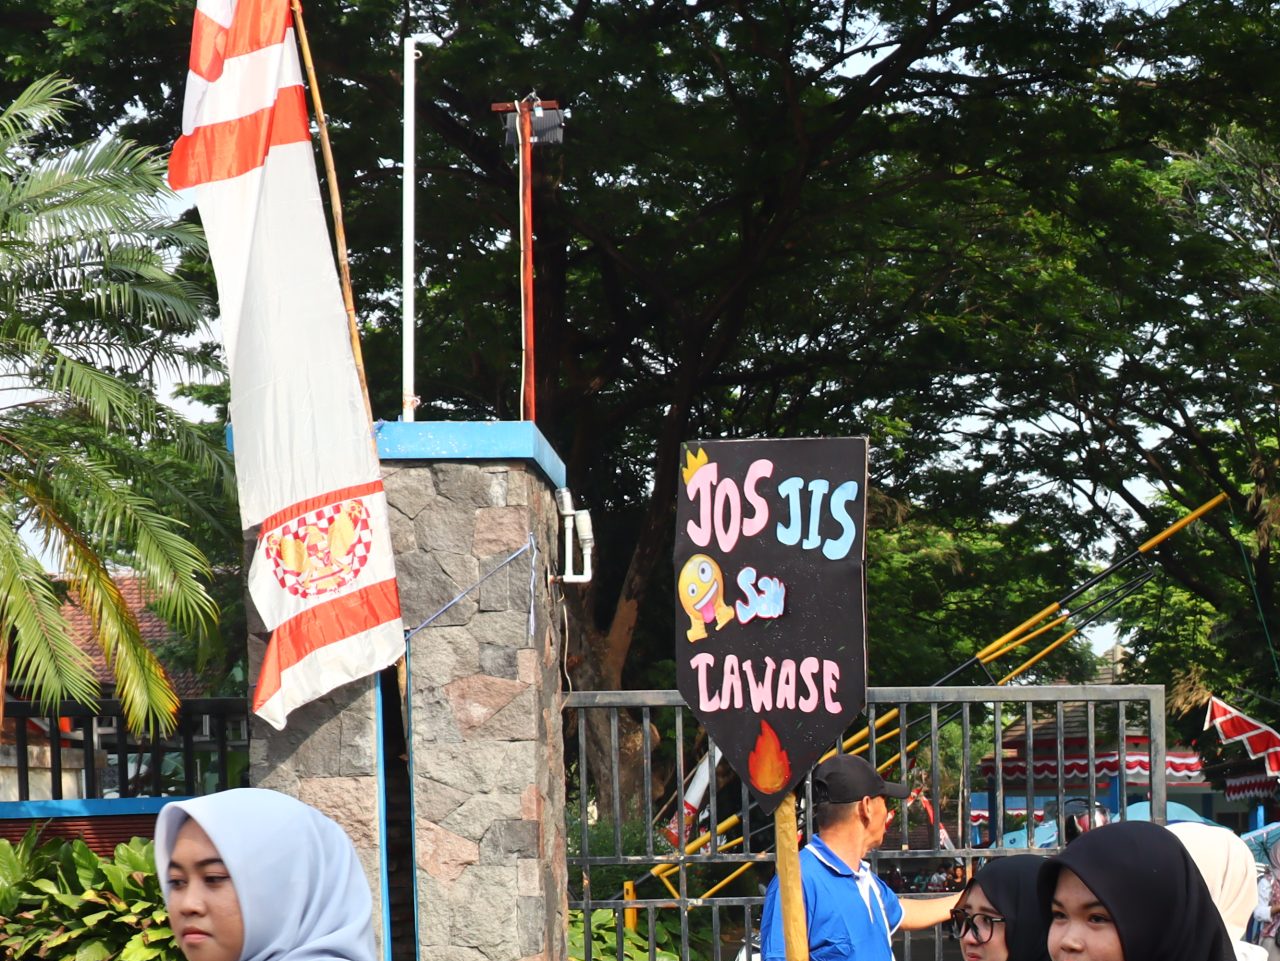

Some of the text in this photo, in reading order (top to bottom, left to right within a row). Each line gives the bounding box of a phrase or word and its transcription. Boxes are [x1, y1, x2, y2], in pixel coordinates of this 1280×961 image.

[686, 458, 859, 561] JOS JIS
[689, 652, 843, 715] LAWASE
